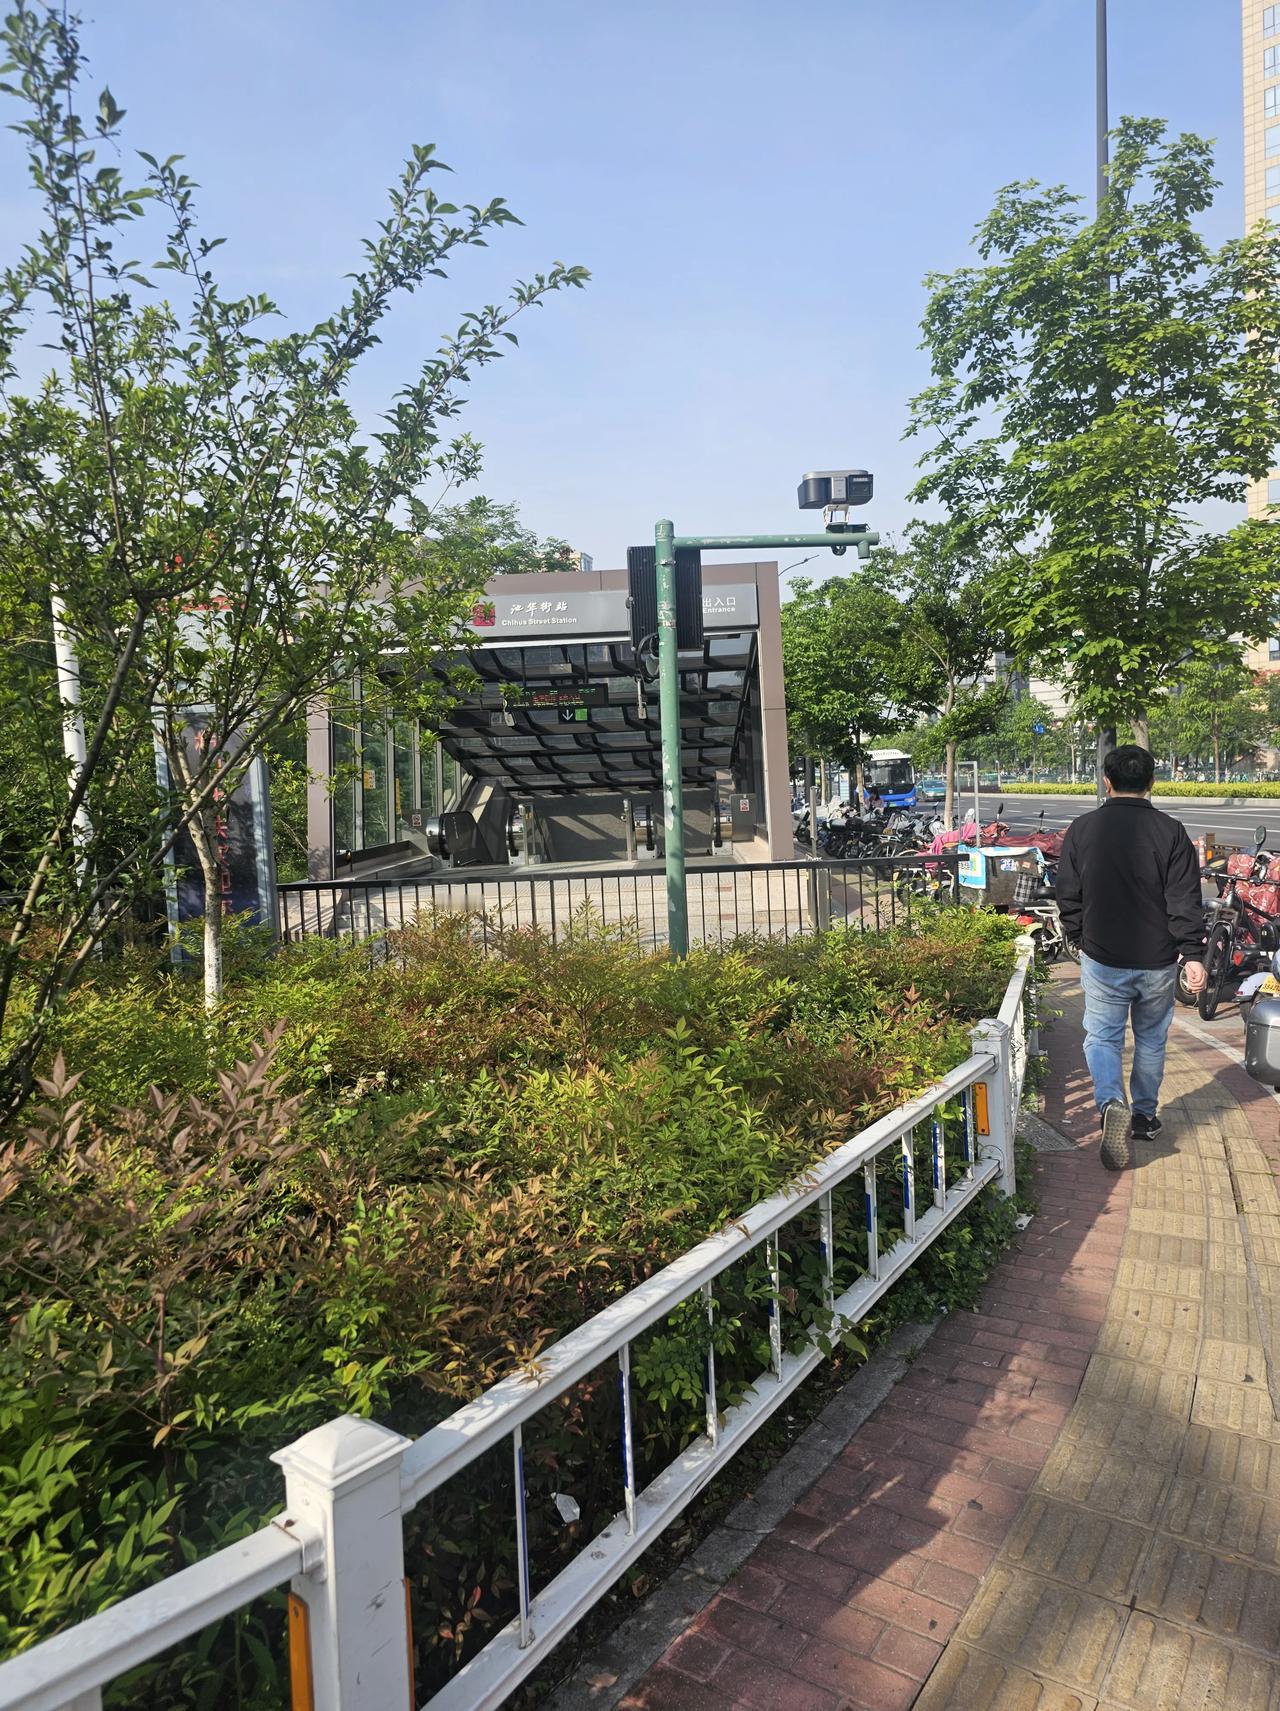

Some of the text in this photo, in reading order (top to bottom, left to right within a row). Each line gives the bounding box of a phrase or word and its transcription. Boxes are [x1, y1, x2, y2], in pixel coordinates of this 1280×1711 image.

[702, 596, 736, 607] 出入口
[551, 616, 577, 624] Station
